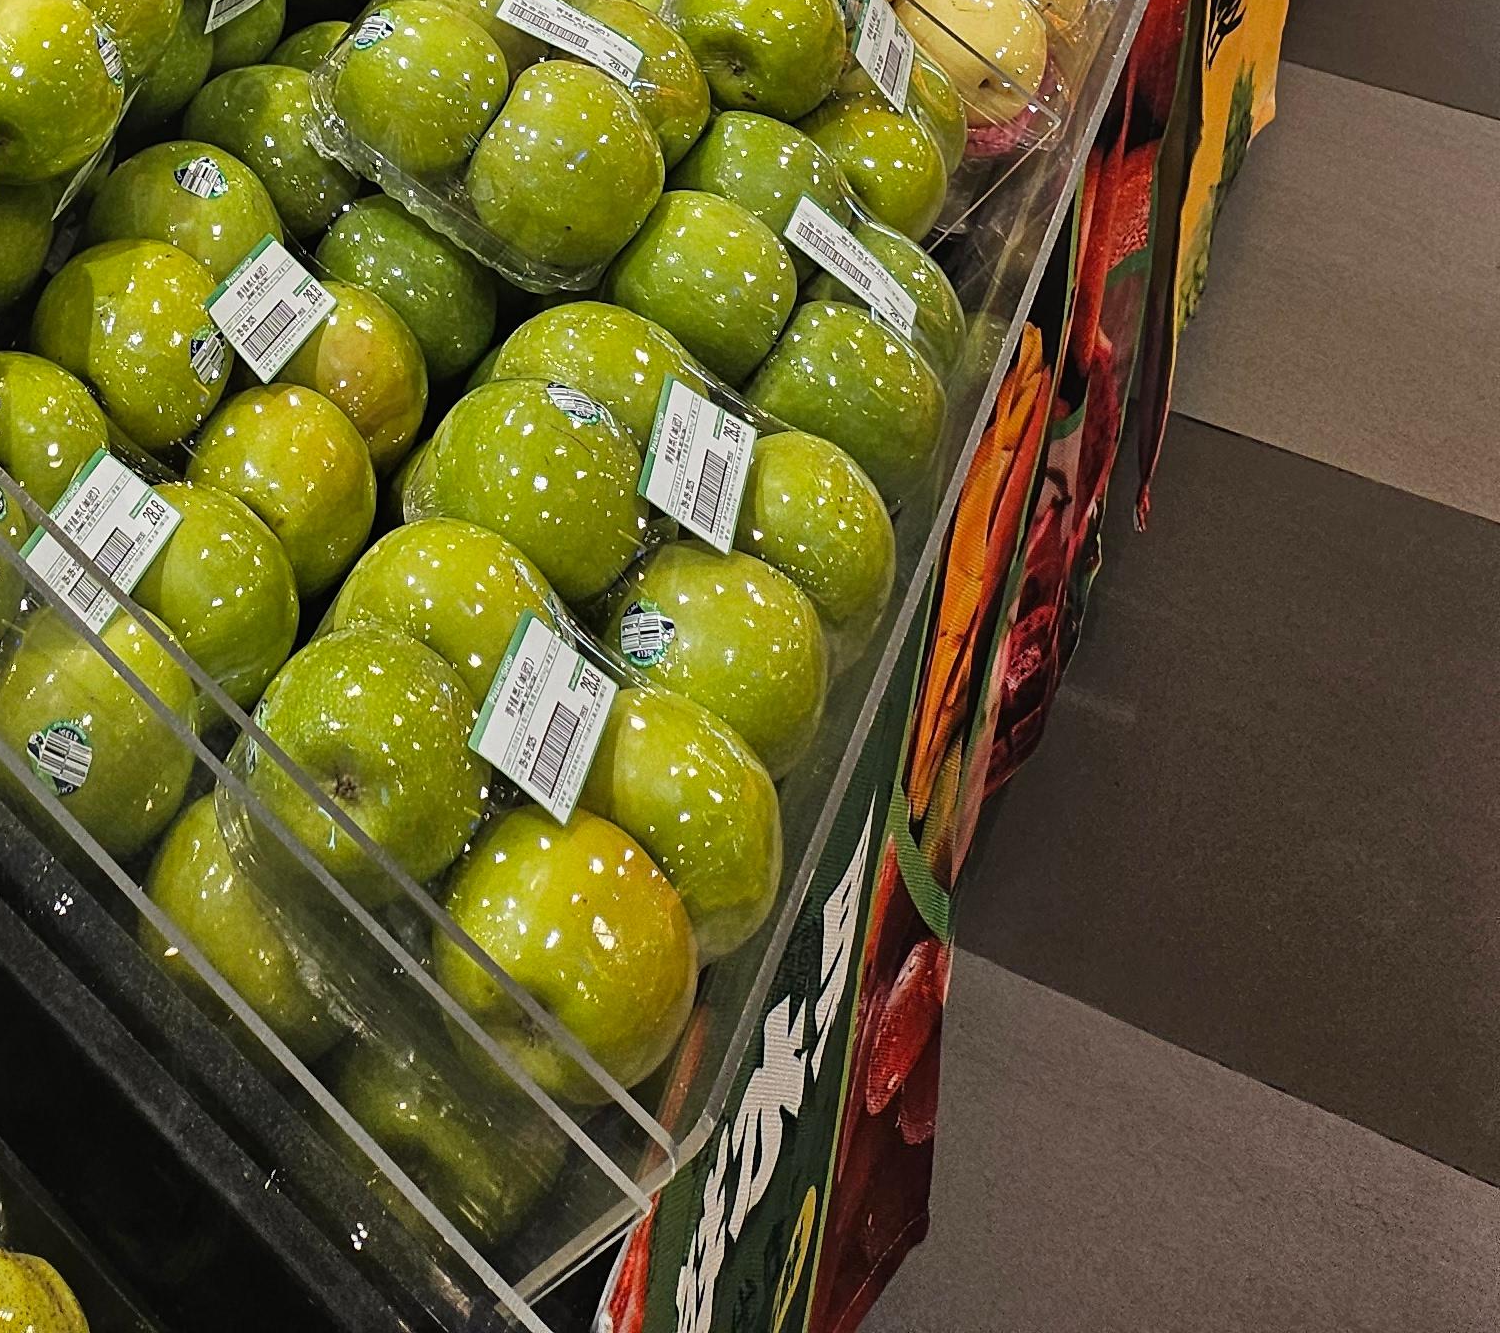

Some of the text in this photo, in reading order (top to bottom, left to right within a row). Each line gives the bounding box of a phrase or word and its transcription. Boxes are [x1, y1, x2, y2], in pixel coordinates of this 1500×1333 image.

[303, 284, 324, 305] 28.8
[722, 418, 742, 443] 28.8
[142, 499, 167, 526] 28.8
[579, 667, 601, 697] 28.8
